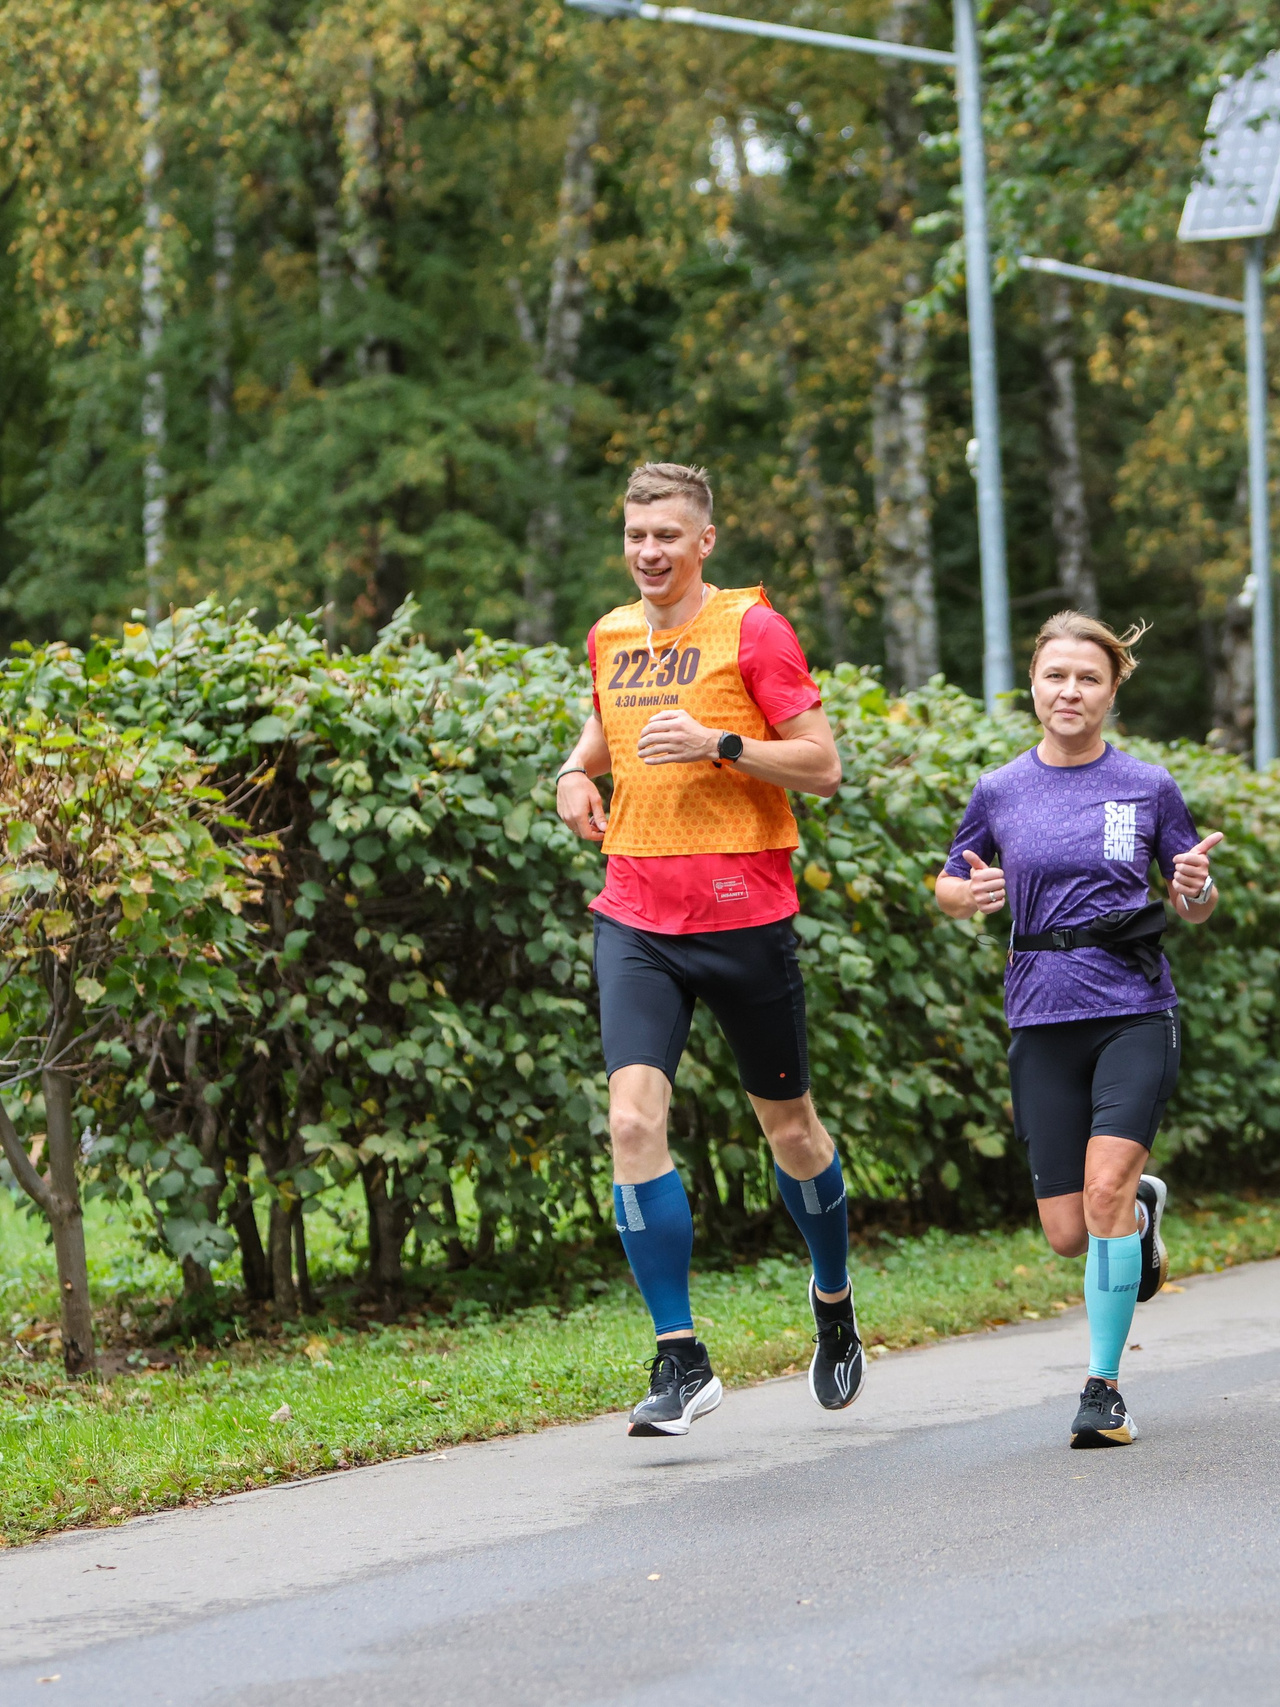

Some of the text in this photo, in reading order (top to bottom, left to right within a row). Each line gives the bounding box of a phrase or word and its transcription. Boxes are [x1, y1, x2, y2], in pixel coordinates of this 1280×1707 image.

[608, 647, 701, 690] 22:30
[615, 695, 637, 708] 4:30
[1104, 801, 1137, 825] Sat
[1103, 840, 1135, 862] 5KM
